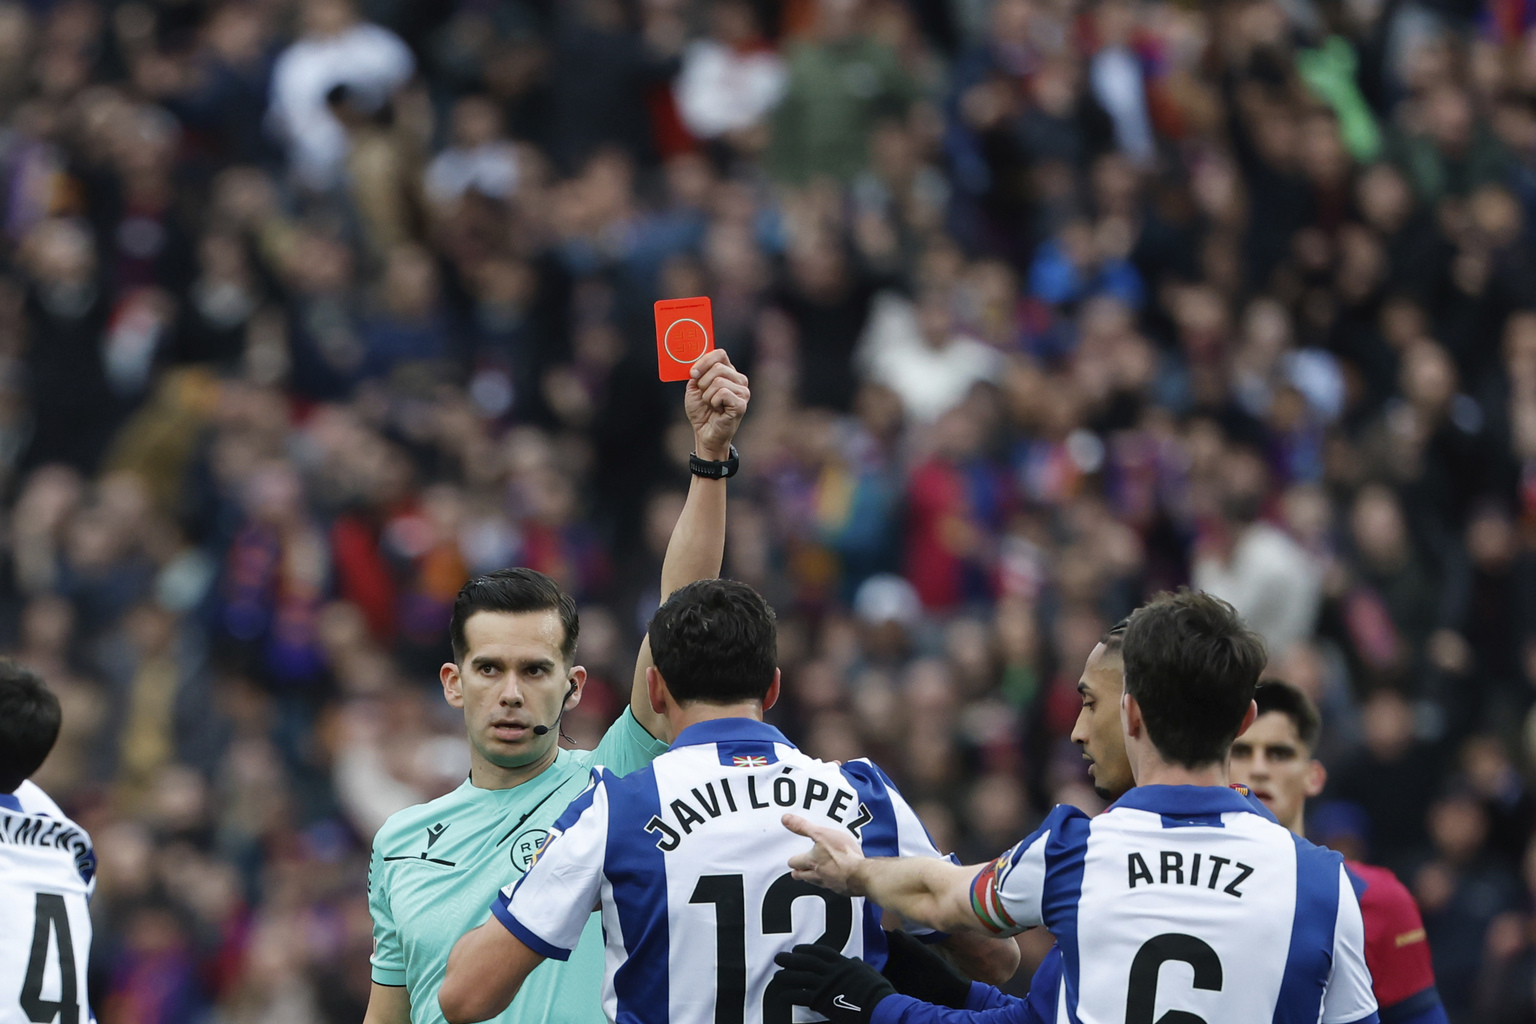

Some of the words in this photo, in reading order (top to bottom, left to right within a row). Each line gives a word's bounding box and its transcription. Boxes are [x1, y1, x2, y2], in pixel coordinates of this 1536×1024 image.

[645, 776, 739, 852] JAVI
[747, 767, 875, 840] LÓPEZ
[1126, 850, 1256, 899] ARITZ
